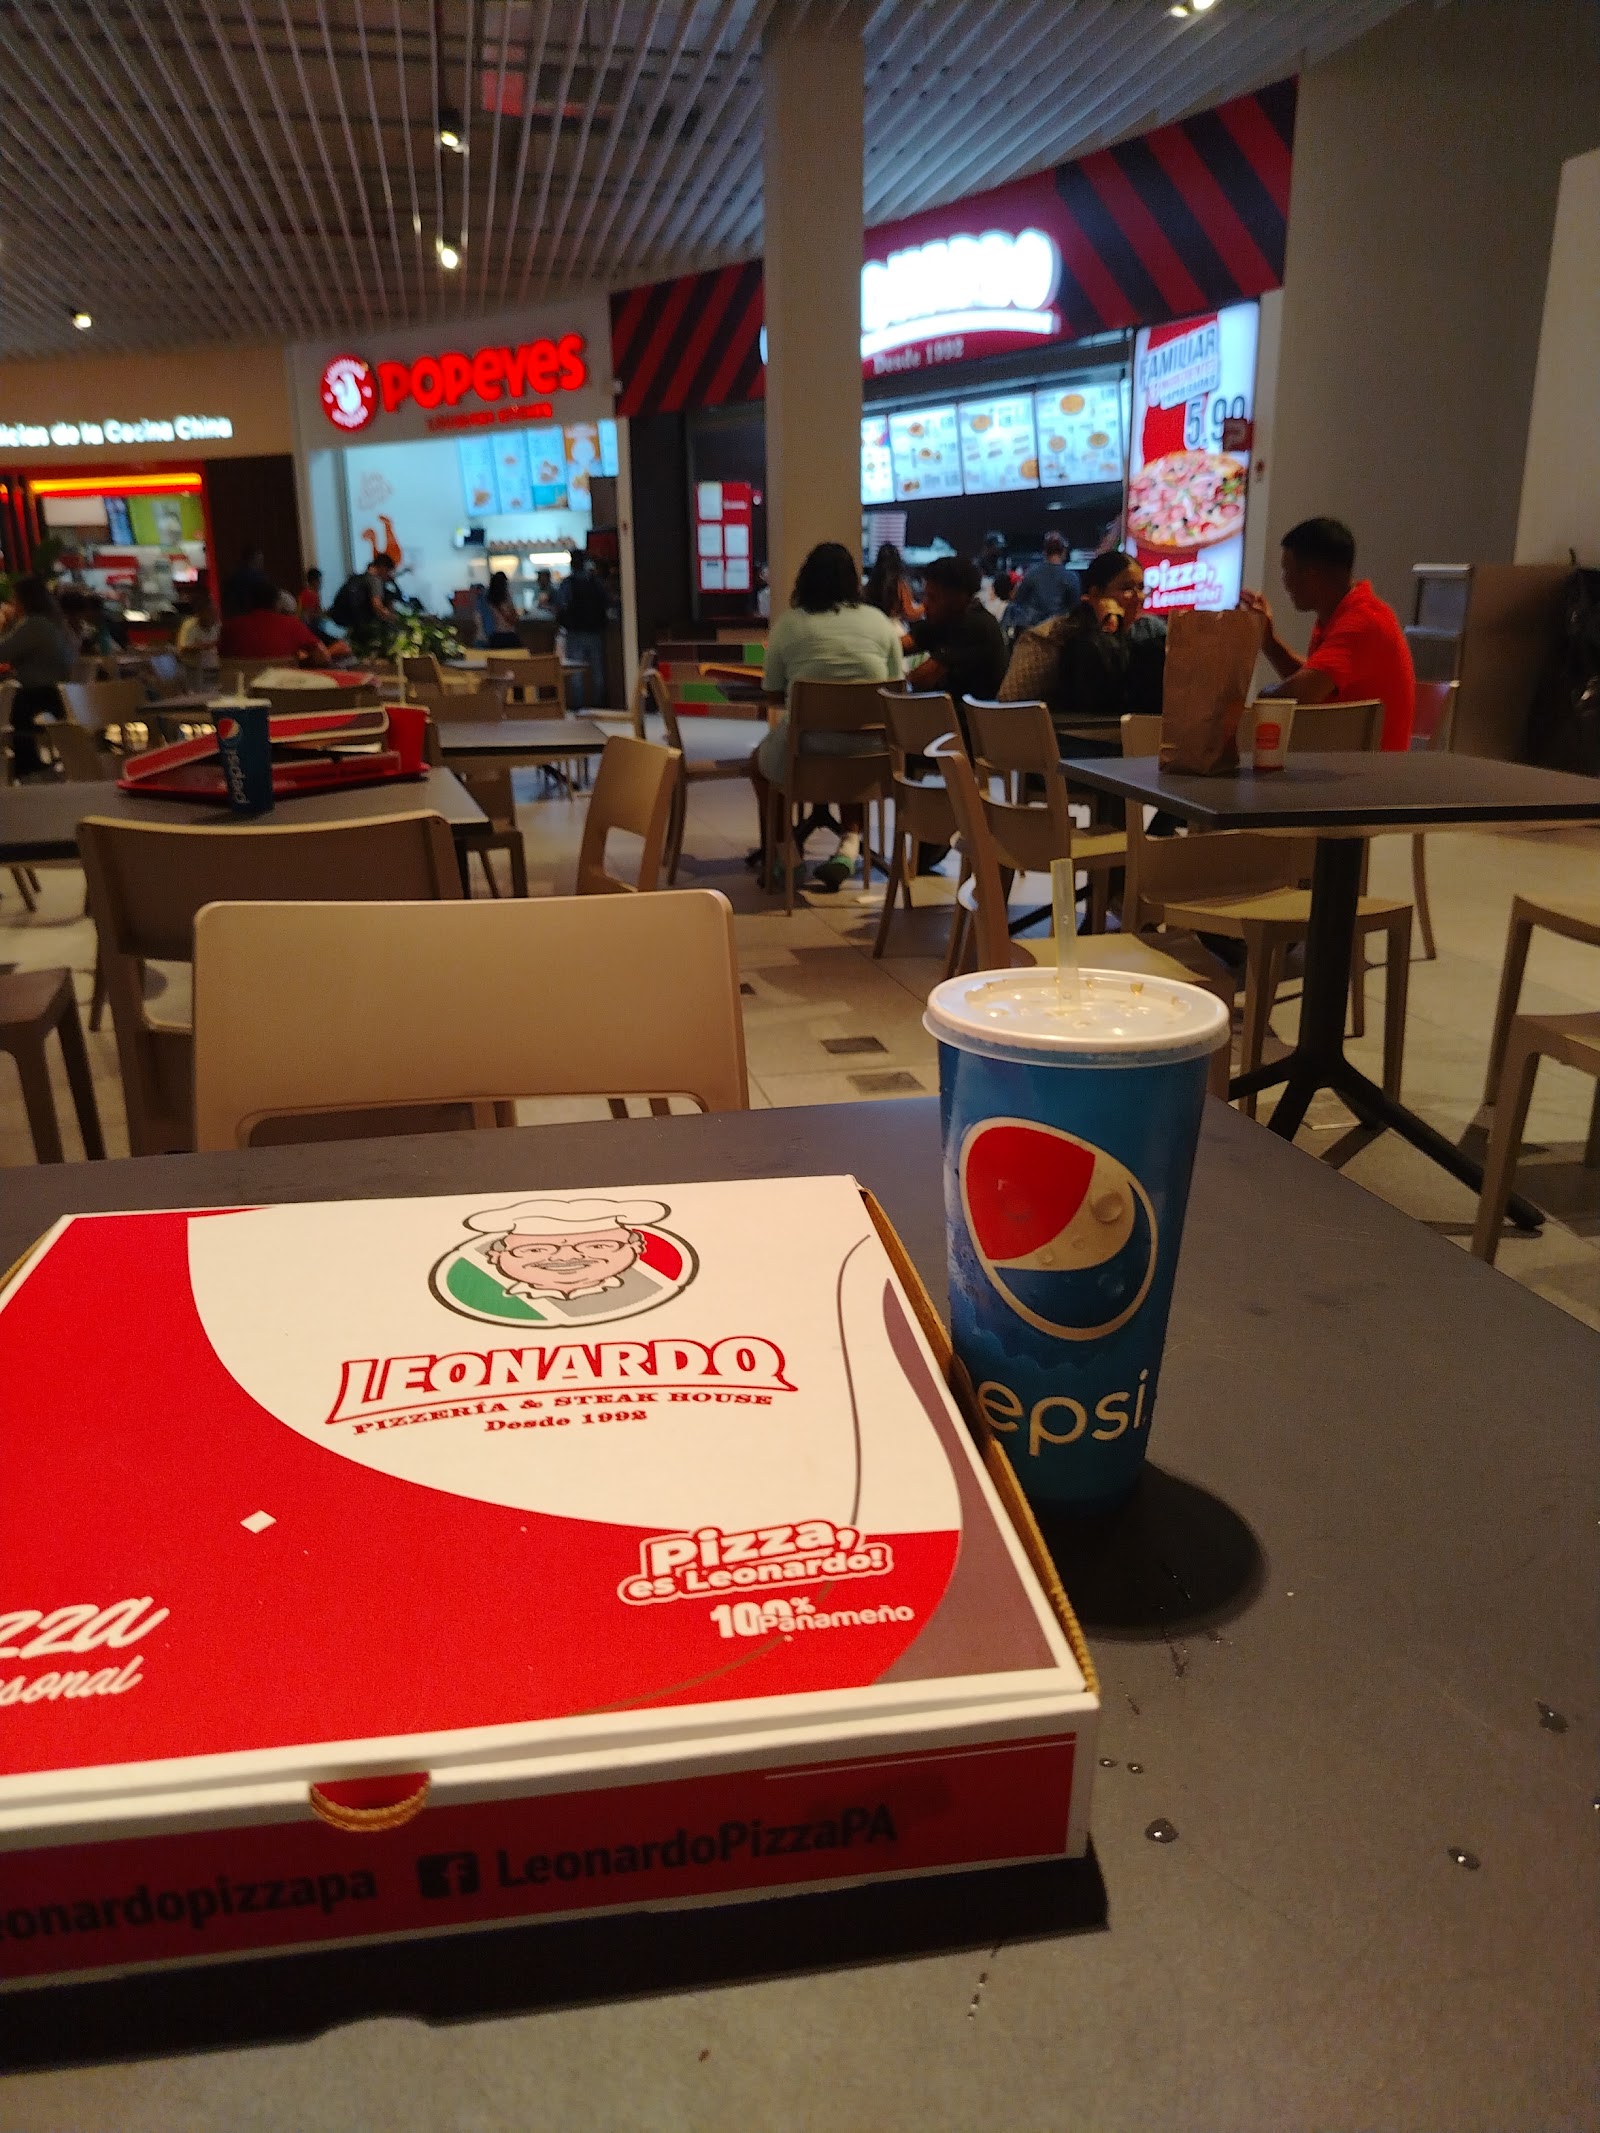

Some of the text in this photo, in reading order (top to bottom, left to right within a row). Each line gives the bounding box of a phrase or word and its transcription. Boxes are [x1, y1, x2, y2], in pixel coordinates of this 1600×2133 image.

[377, 332, 586, 413] POPEYES
[1139, 328, 1216, 391] FAMILIAR
[50, 421, 80, 446] de
[103, 418, 175, 444] Cocina
[173, 414, 233, 441] China
[326, 1336, 798, 1424] LEONARDO
[353, 1391, 773, 1435] PIZZERÍA & STEAK HOUSE
[484, 1409, 648, 1432] Desde 1992
[978, 1367, 1149, 1457] epsi
[627, 1549, 885, 1599] es Leonardo!
[649, 1521, 857, 1577] Pizza,
[759, 1604, 915, 1635] Panameño
[496, 1804, 900, 1889] LeonardoPizzaPA
[0, 1868, 379, 1940] onardopizzapa
